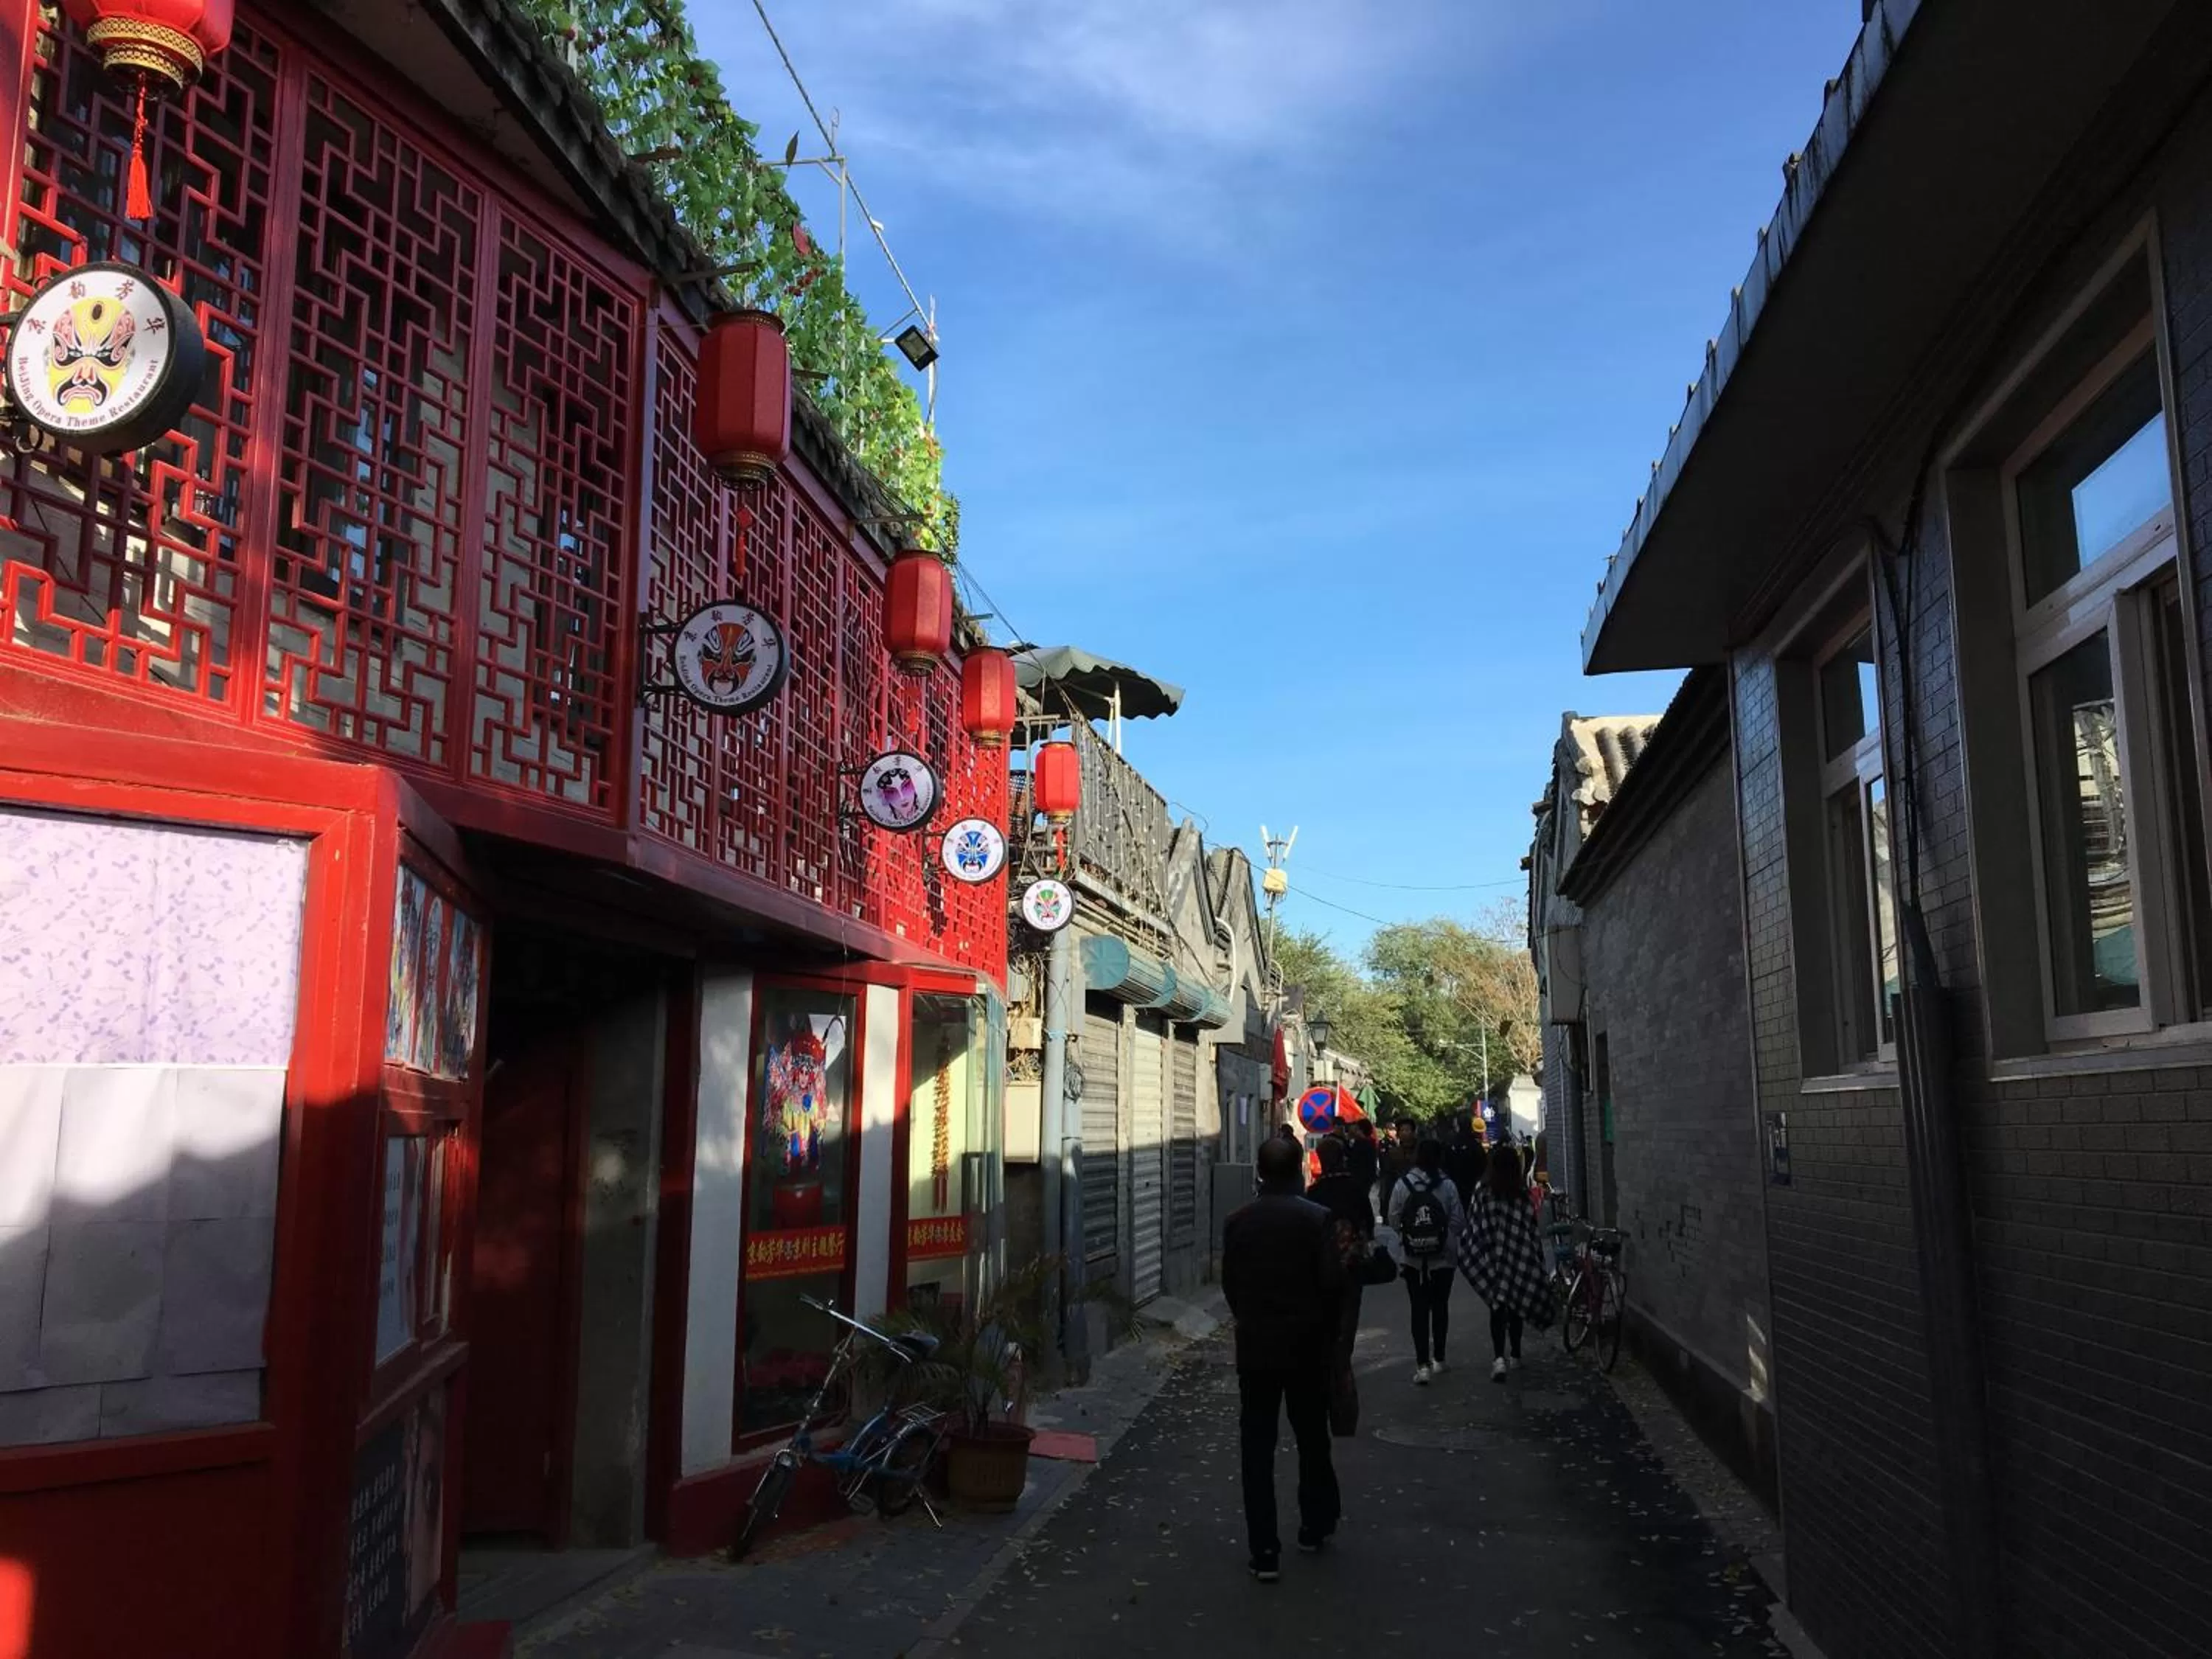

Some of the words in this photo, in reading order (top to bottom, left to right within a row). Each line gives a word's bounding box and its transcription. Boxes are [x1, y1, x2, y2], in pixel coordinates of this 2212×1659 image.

[32, 400, 62, 425] Opera
[66, 414, 105, 427] Theme
[108, 359, 159, 417] Restaurant
